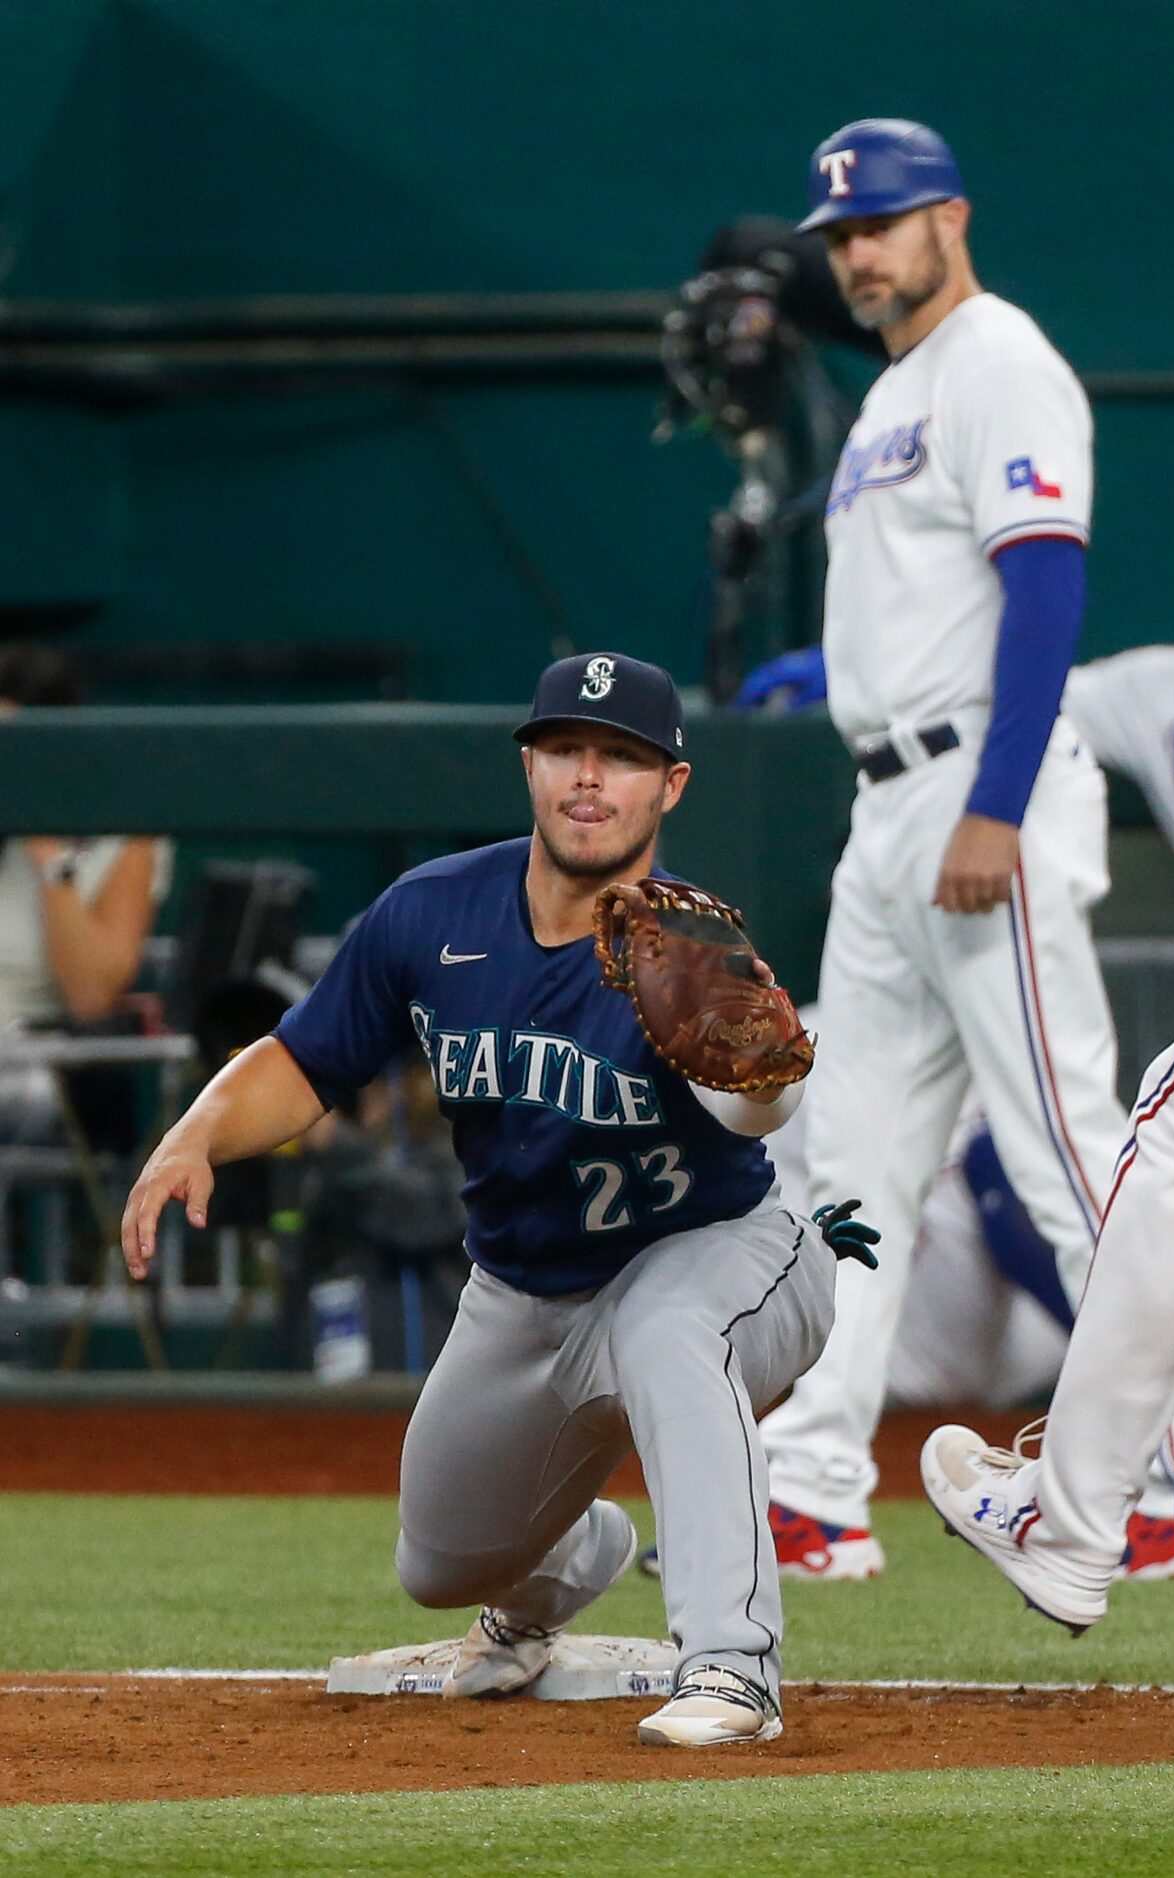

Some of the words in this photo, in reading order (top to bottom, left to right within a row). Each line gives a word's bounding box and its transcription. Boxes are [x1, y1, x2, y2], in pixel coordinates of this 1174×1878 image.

[819, 149, 856, 199] T
[580, 656, 617, 702] S
[409, 1001, 664, 1128] SEATTLE
[571, 1143, 694, 1233] 23
